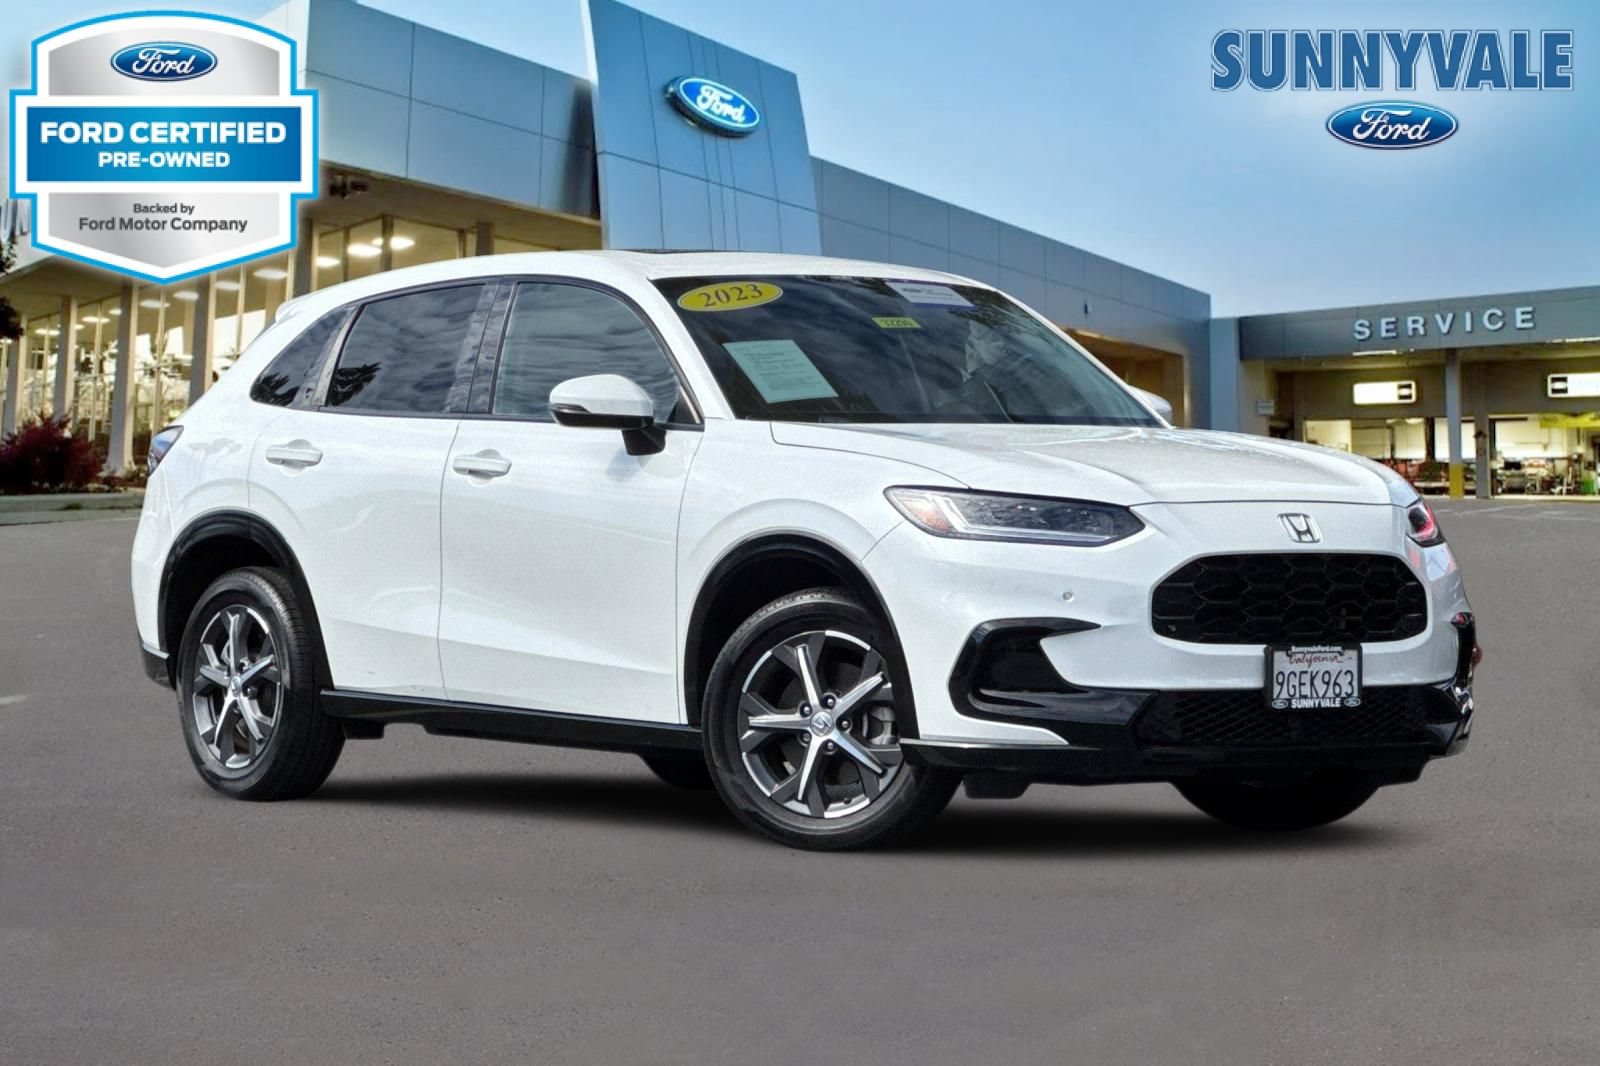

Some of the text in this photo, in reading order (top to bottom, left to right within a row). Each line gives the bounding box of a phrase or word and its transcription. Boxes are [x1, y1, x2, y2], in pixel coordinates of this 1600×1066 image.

[696, 84, 746, 123] Ford
[697, 283, 763, 307] 2023
[1353, 306, 1535, 340] SERVICE
[1288, 653, 1344, 668] California
[1275, 670, 1355, 699] 9GEK963
[1291, 698, 1341, 709] SUNNYVALE
